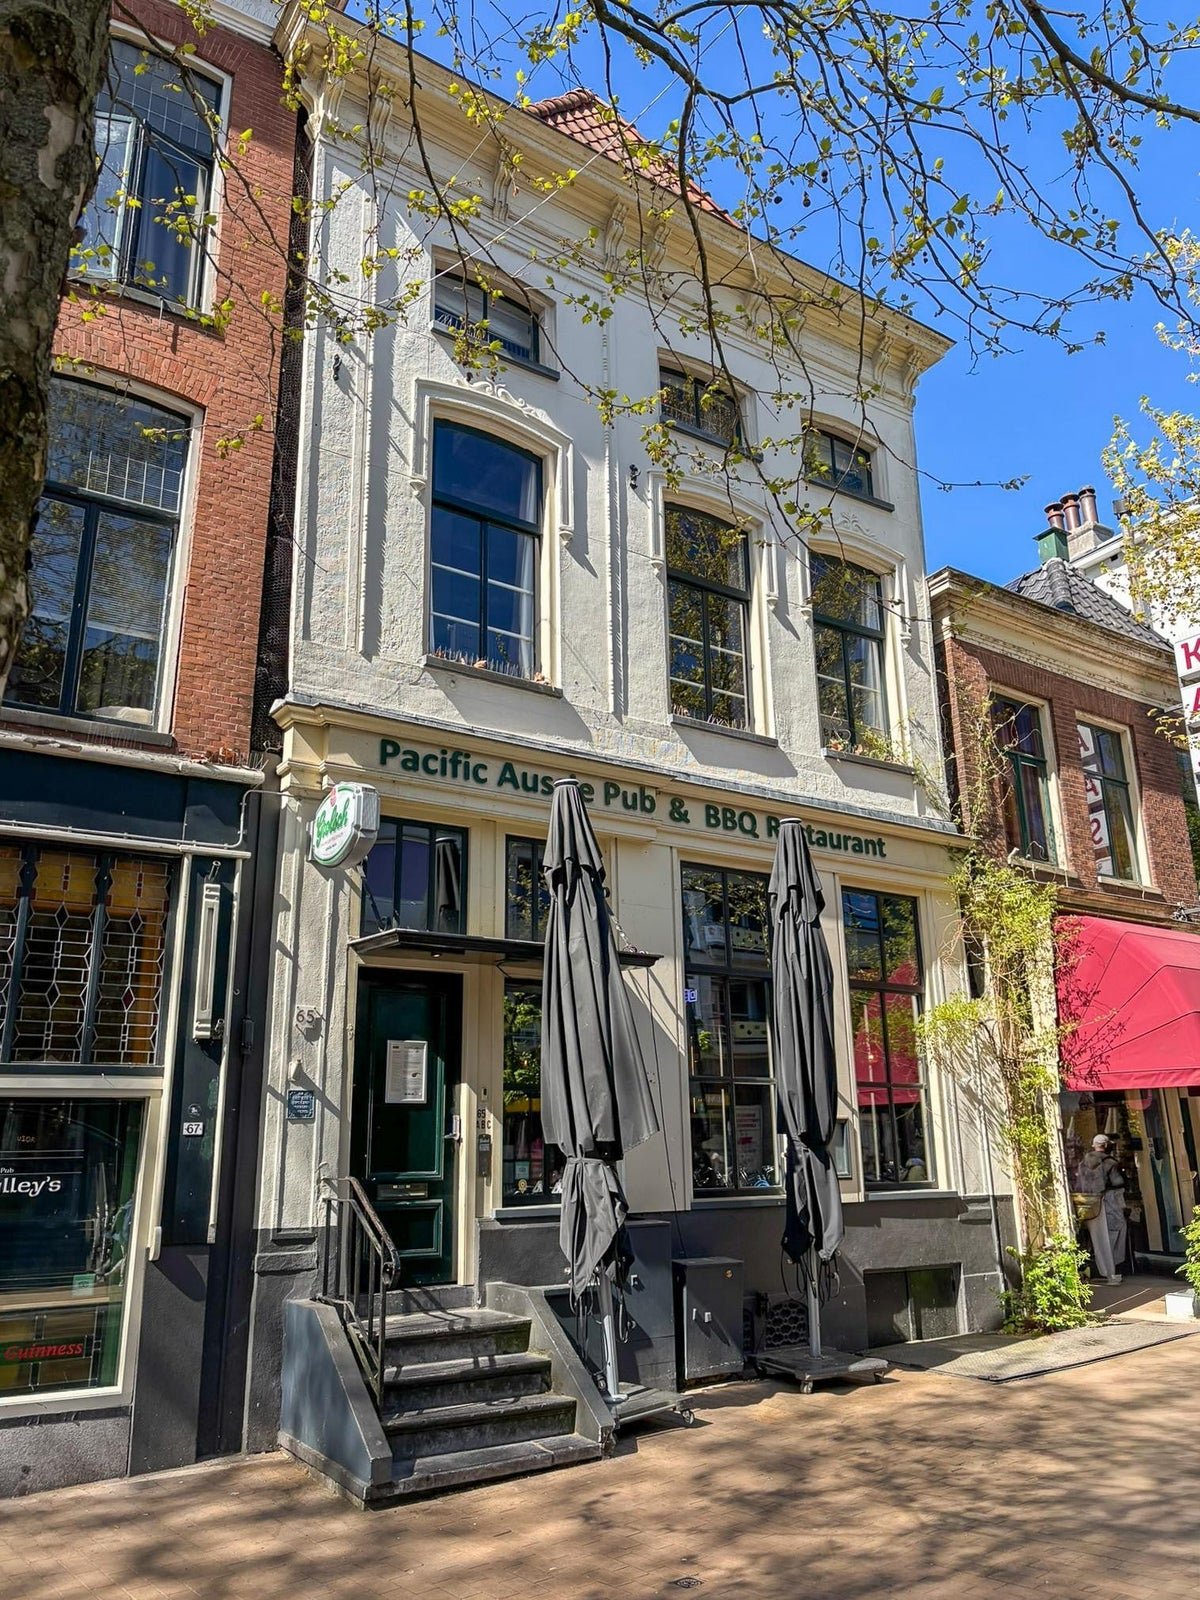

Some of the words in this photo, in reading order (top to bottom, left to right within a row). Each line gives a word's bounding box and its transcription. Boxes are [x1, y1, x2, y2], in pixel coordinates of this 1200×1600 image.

[380, 738, 488, 785] Pacific
[497, 761, 594, 803] Ause
[604, 782, 656, 814] Pub
[669, 796, 690, 824] &
[705, 804, 760, 839] BBQ
[767, 816, 887, 858] Rtaurant
[296, 1009, 315, 1024] 65
[477, 1108, 486, 1119] 65
[186, 1123, 200, 1134] 67
[0, 1176, 61, 1197] lley's
[4, 1343, 84, 1360] Guinness
